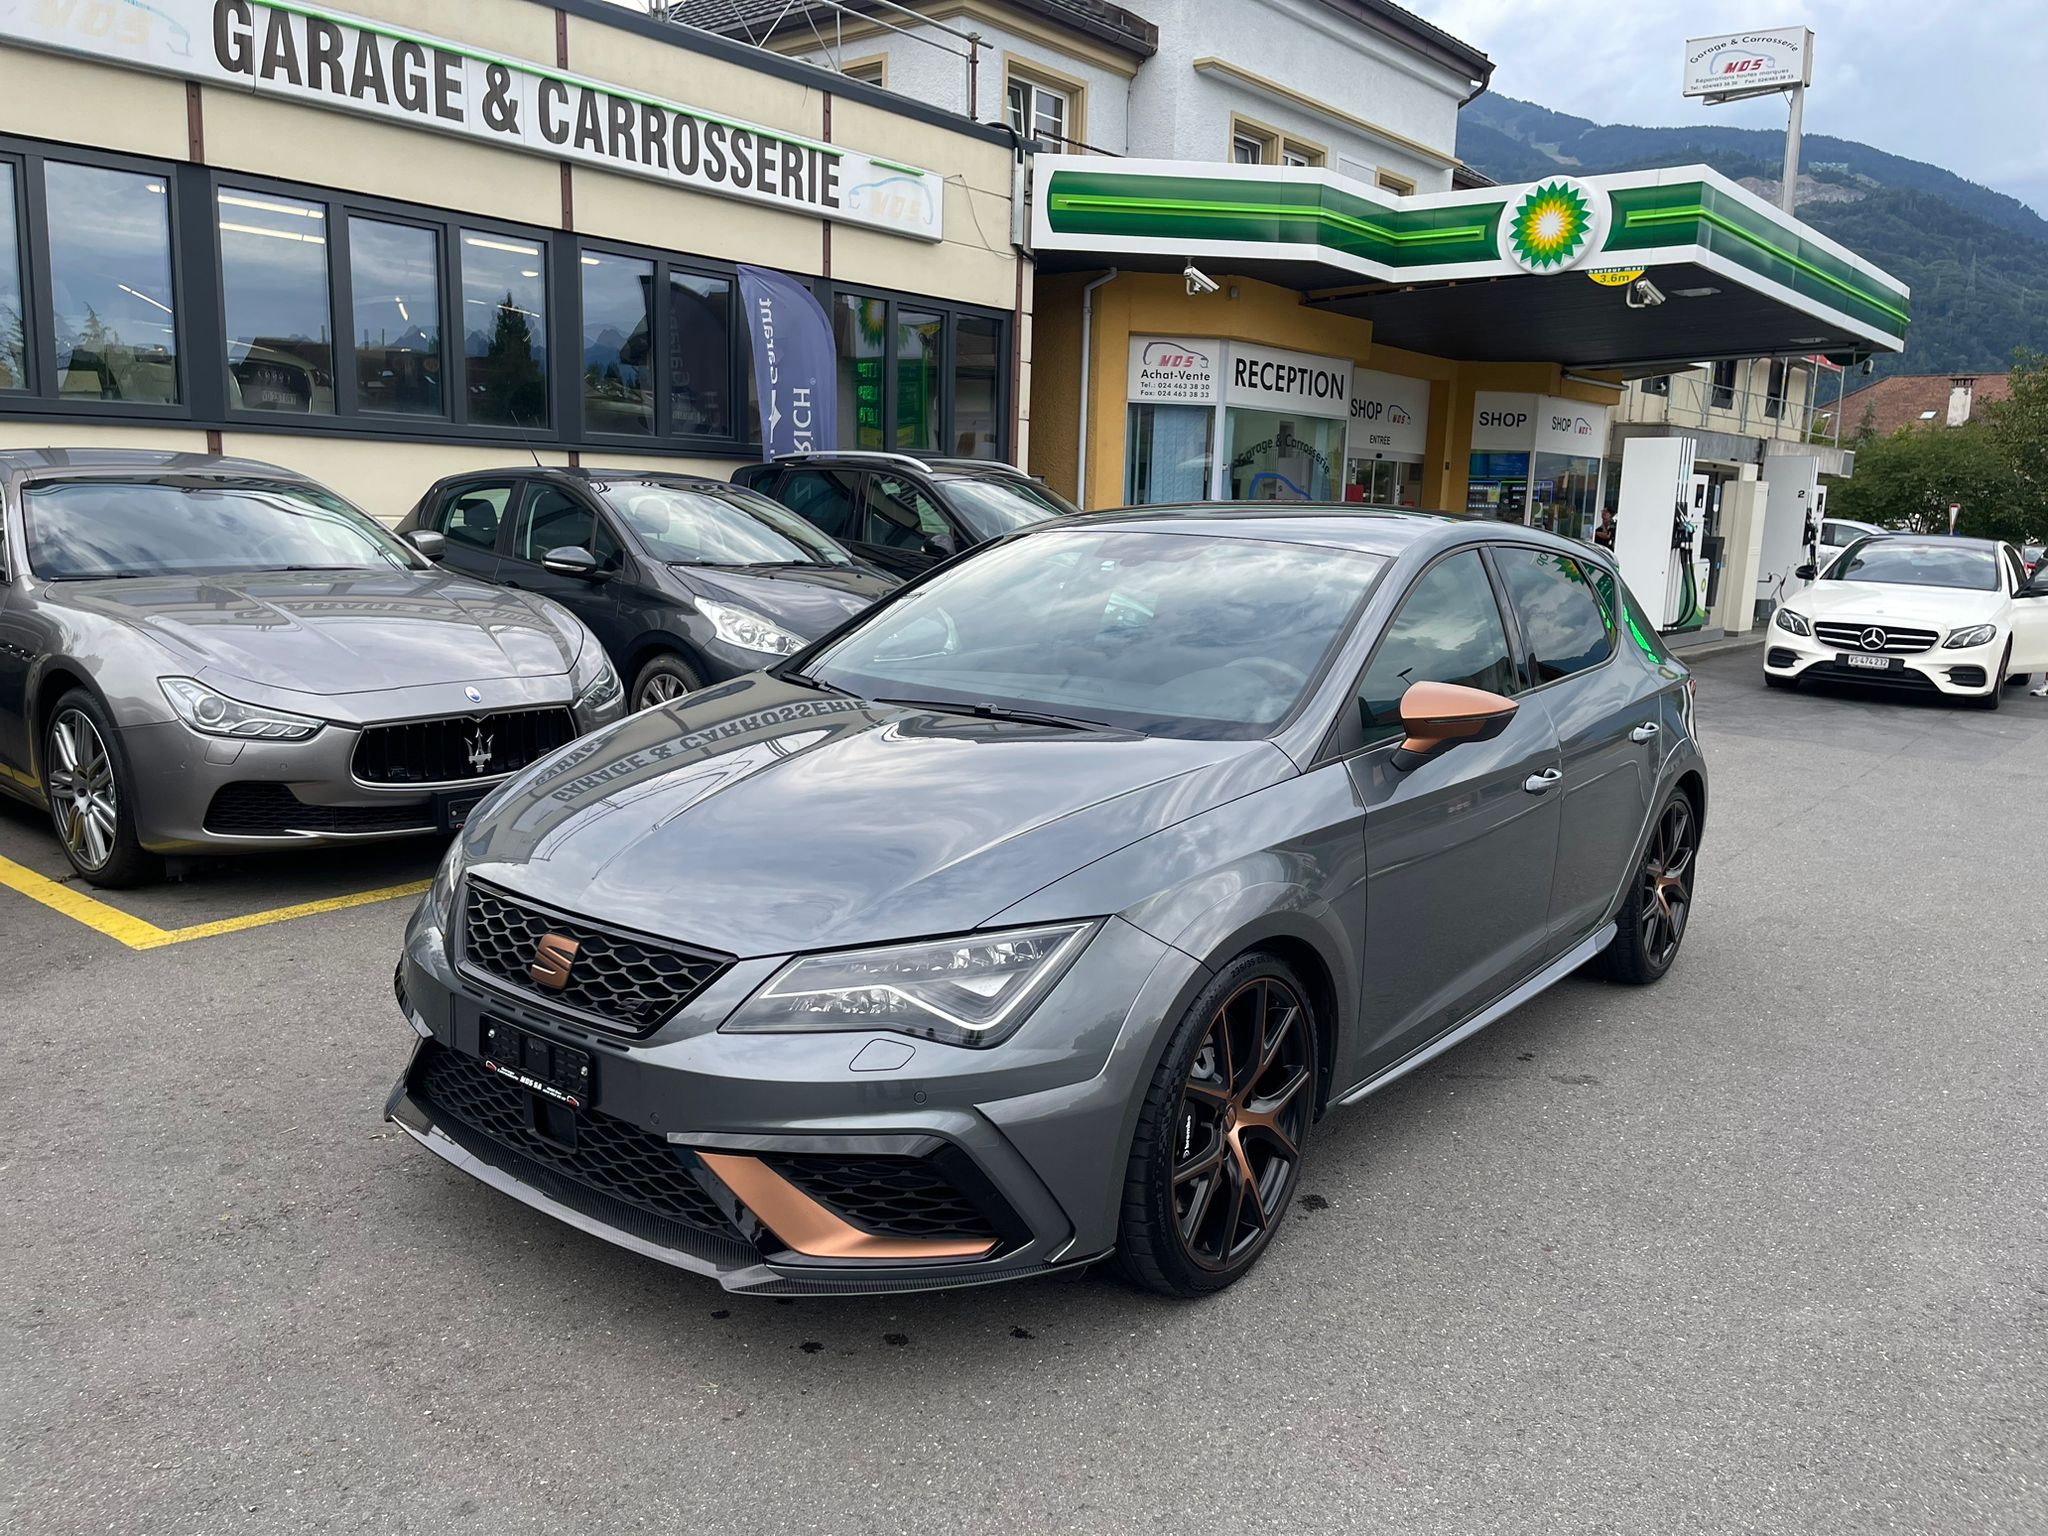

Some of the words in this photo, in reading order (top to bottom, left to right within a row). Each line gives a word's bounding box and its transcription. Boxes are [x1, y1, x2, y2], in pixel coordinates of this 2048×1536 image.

[1690, 42, 1727, 64] Garage
[1742, 36, 1799, 52] Carrosserie
[1723, 59, 1764, 74] MDS
[213, 0, 465, 123] GARAGE
[482, 63, 520, 135] &
[538, 77, 841, 209] CARROSSERIE
[1600, 274, 1630, 283] 3.6m
[1158, 354, 1195, 368] MDS
[1141, 369, 1211, 381] Achat-Vente
[1234, 358, 1345, 400] RECEPTION
[1350, 398, 1383, 420] SHOP
[1479, 411, 1527, 428] SHOP
[1551, 416, 1572, 432] SHOP
[1238, 439, 1273, 465] Garage
[1275, 433, 1282, 447] &
[1285, 433, 1330, 474] Carrosserie
[1797, 490, 1805, 498] 2
[1184, 1114, 1192, 1150] brembo
